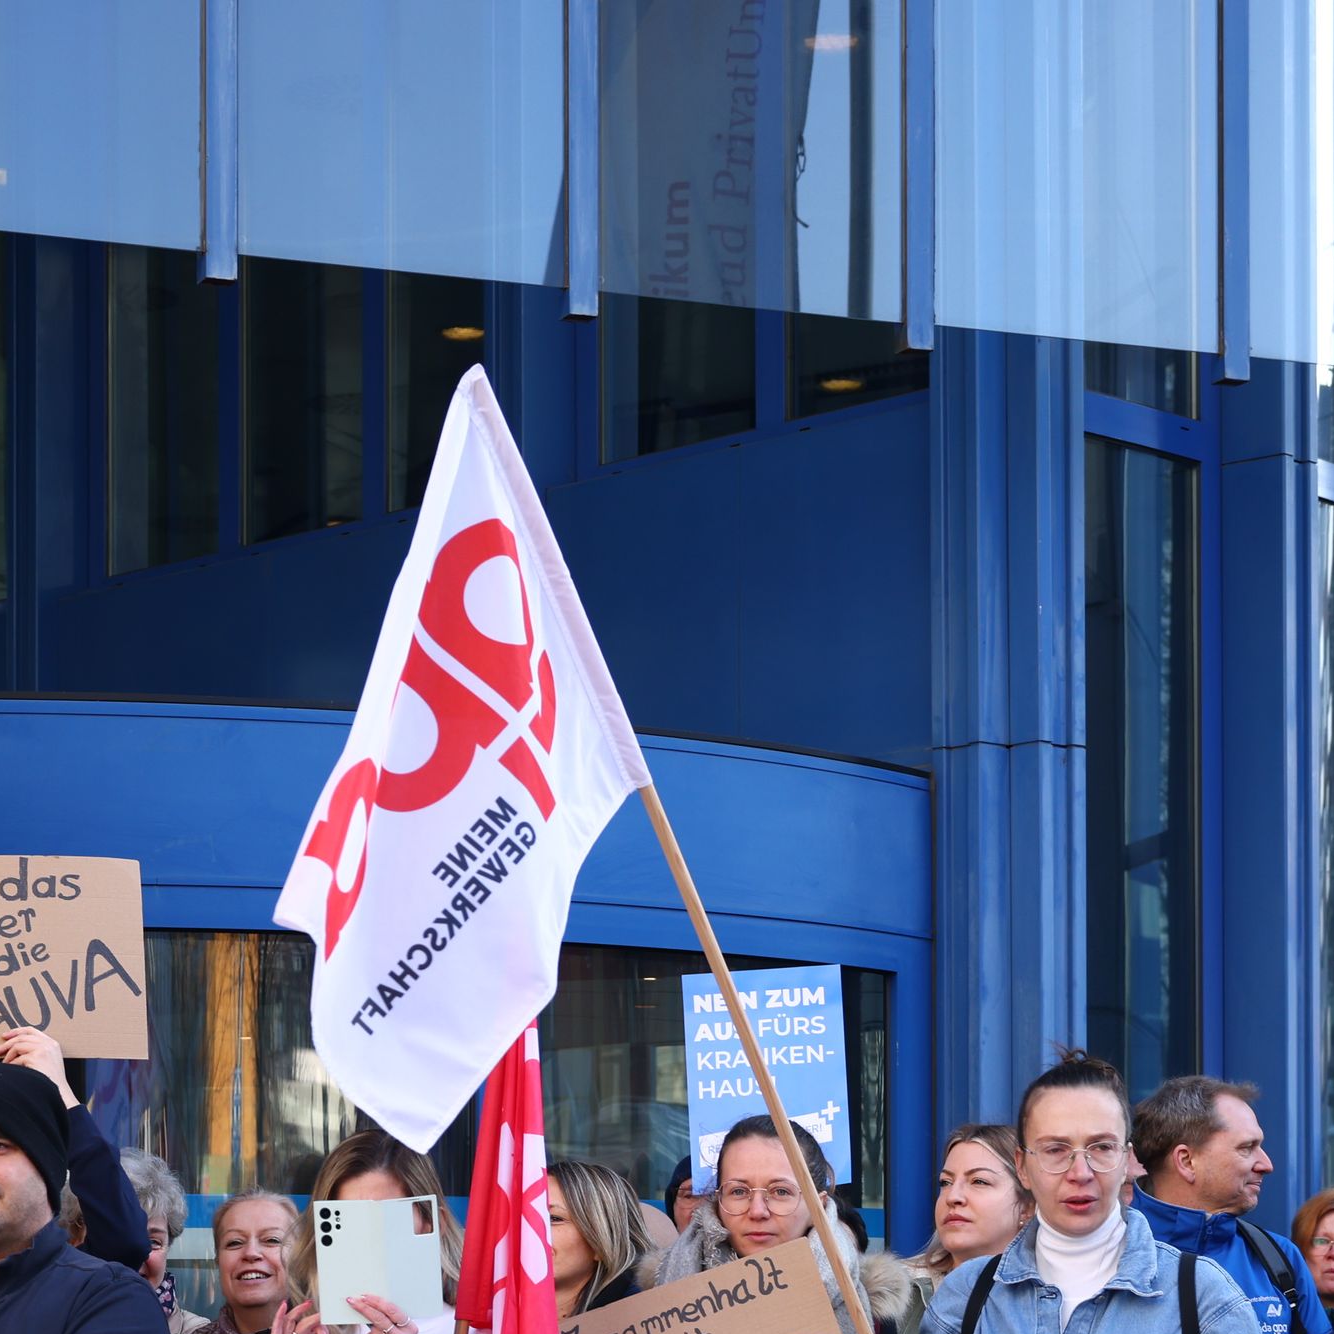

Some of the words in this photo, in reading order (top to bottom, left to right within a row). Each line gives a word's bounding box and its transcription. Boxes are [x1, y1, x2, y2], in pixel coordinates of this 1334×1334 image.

[693, 990, 758, 1014] NEN
[765, 986, 826, 1009] ZUM
[758, 1013, 826, 1038] FÜRS
[696, 1044, 835, 1071] KRAKEN-
